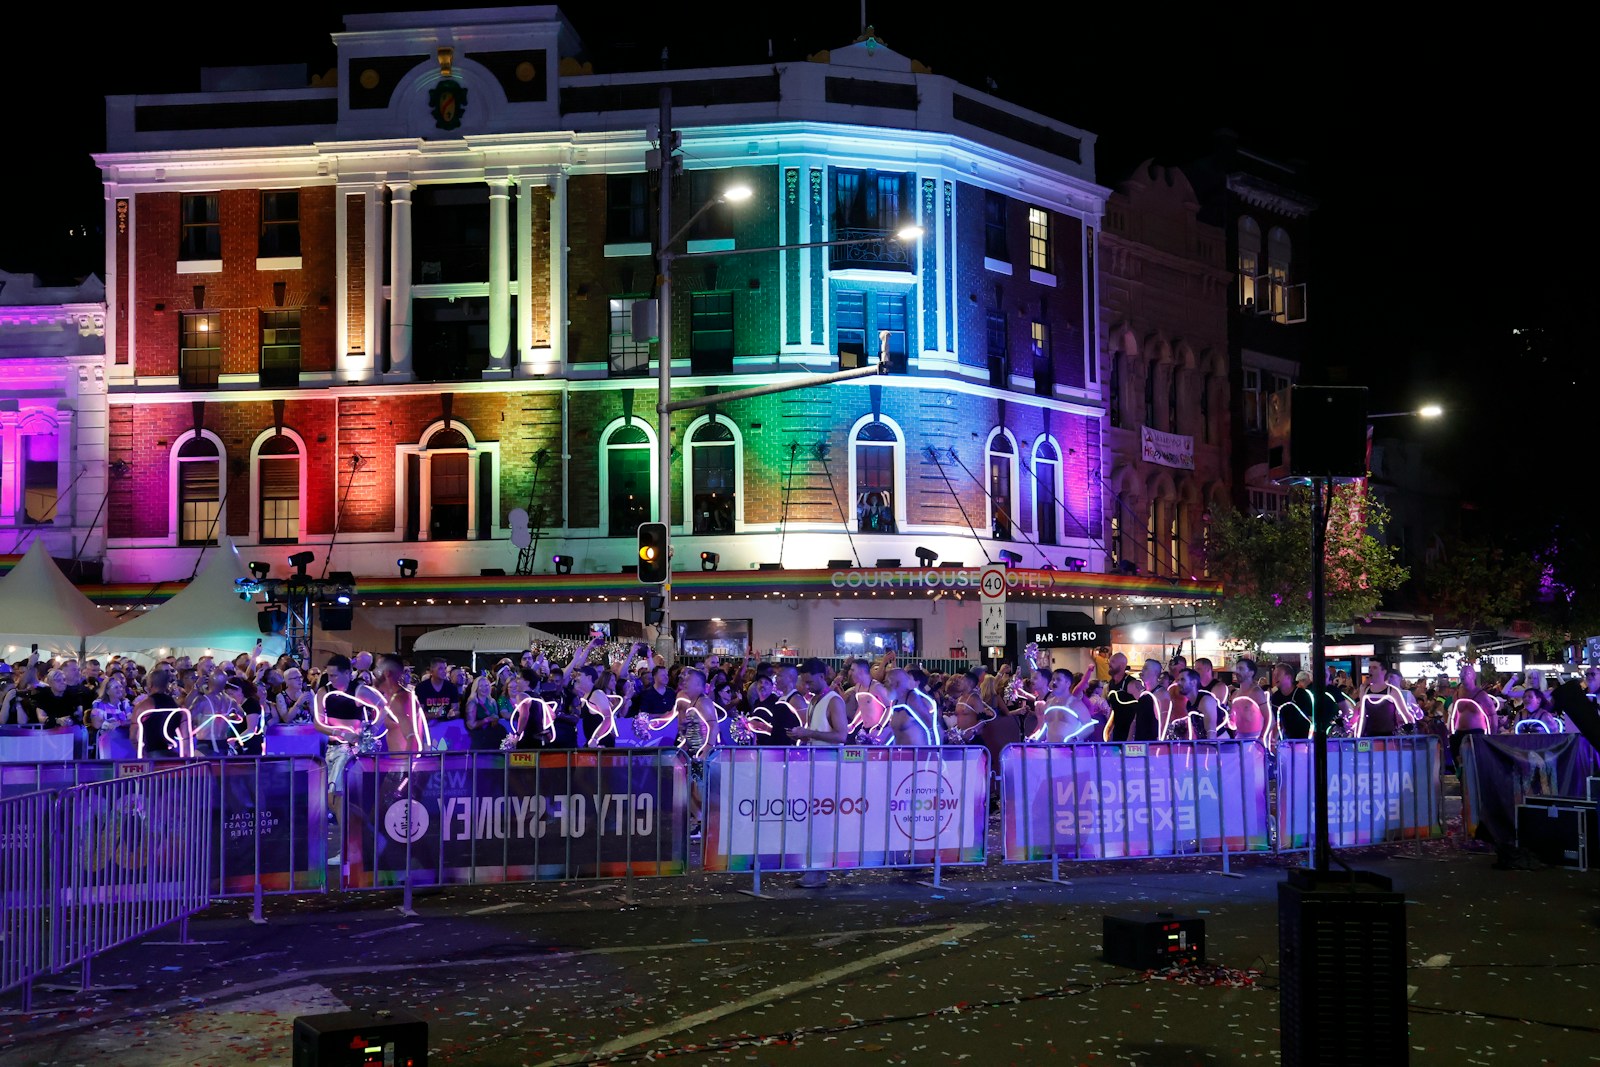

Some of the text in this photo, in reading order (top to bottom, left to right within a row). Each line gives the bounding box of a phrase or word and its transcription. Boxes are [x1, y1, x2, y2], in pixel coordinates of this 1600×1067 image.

[831, 570, 1045, 588] COURTHOUSE OTEL
[985, 577, 1002, 590] 40
[1035, 631, 1097, 642] BAR BISTRO
[512, 753, 532, 761] TFH
[845, 750, 861, 758] TFH
[122, 765, 144, 773] TFH
